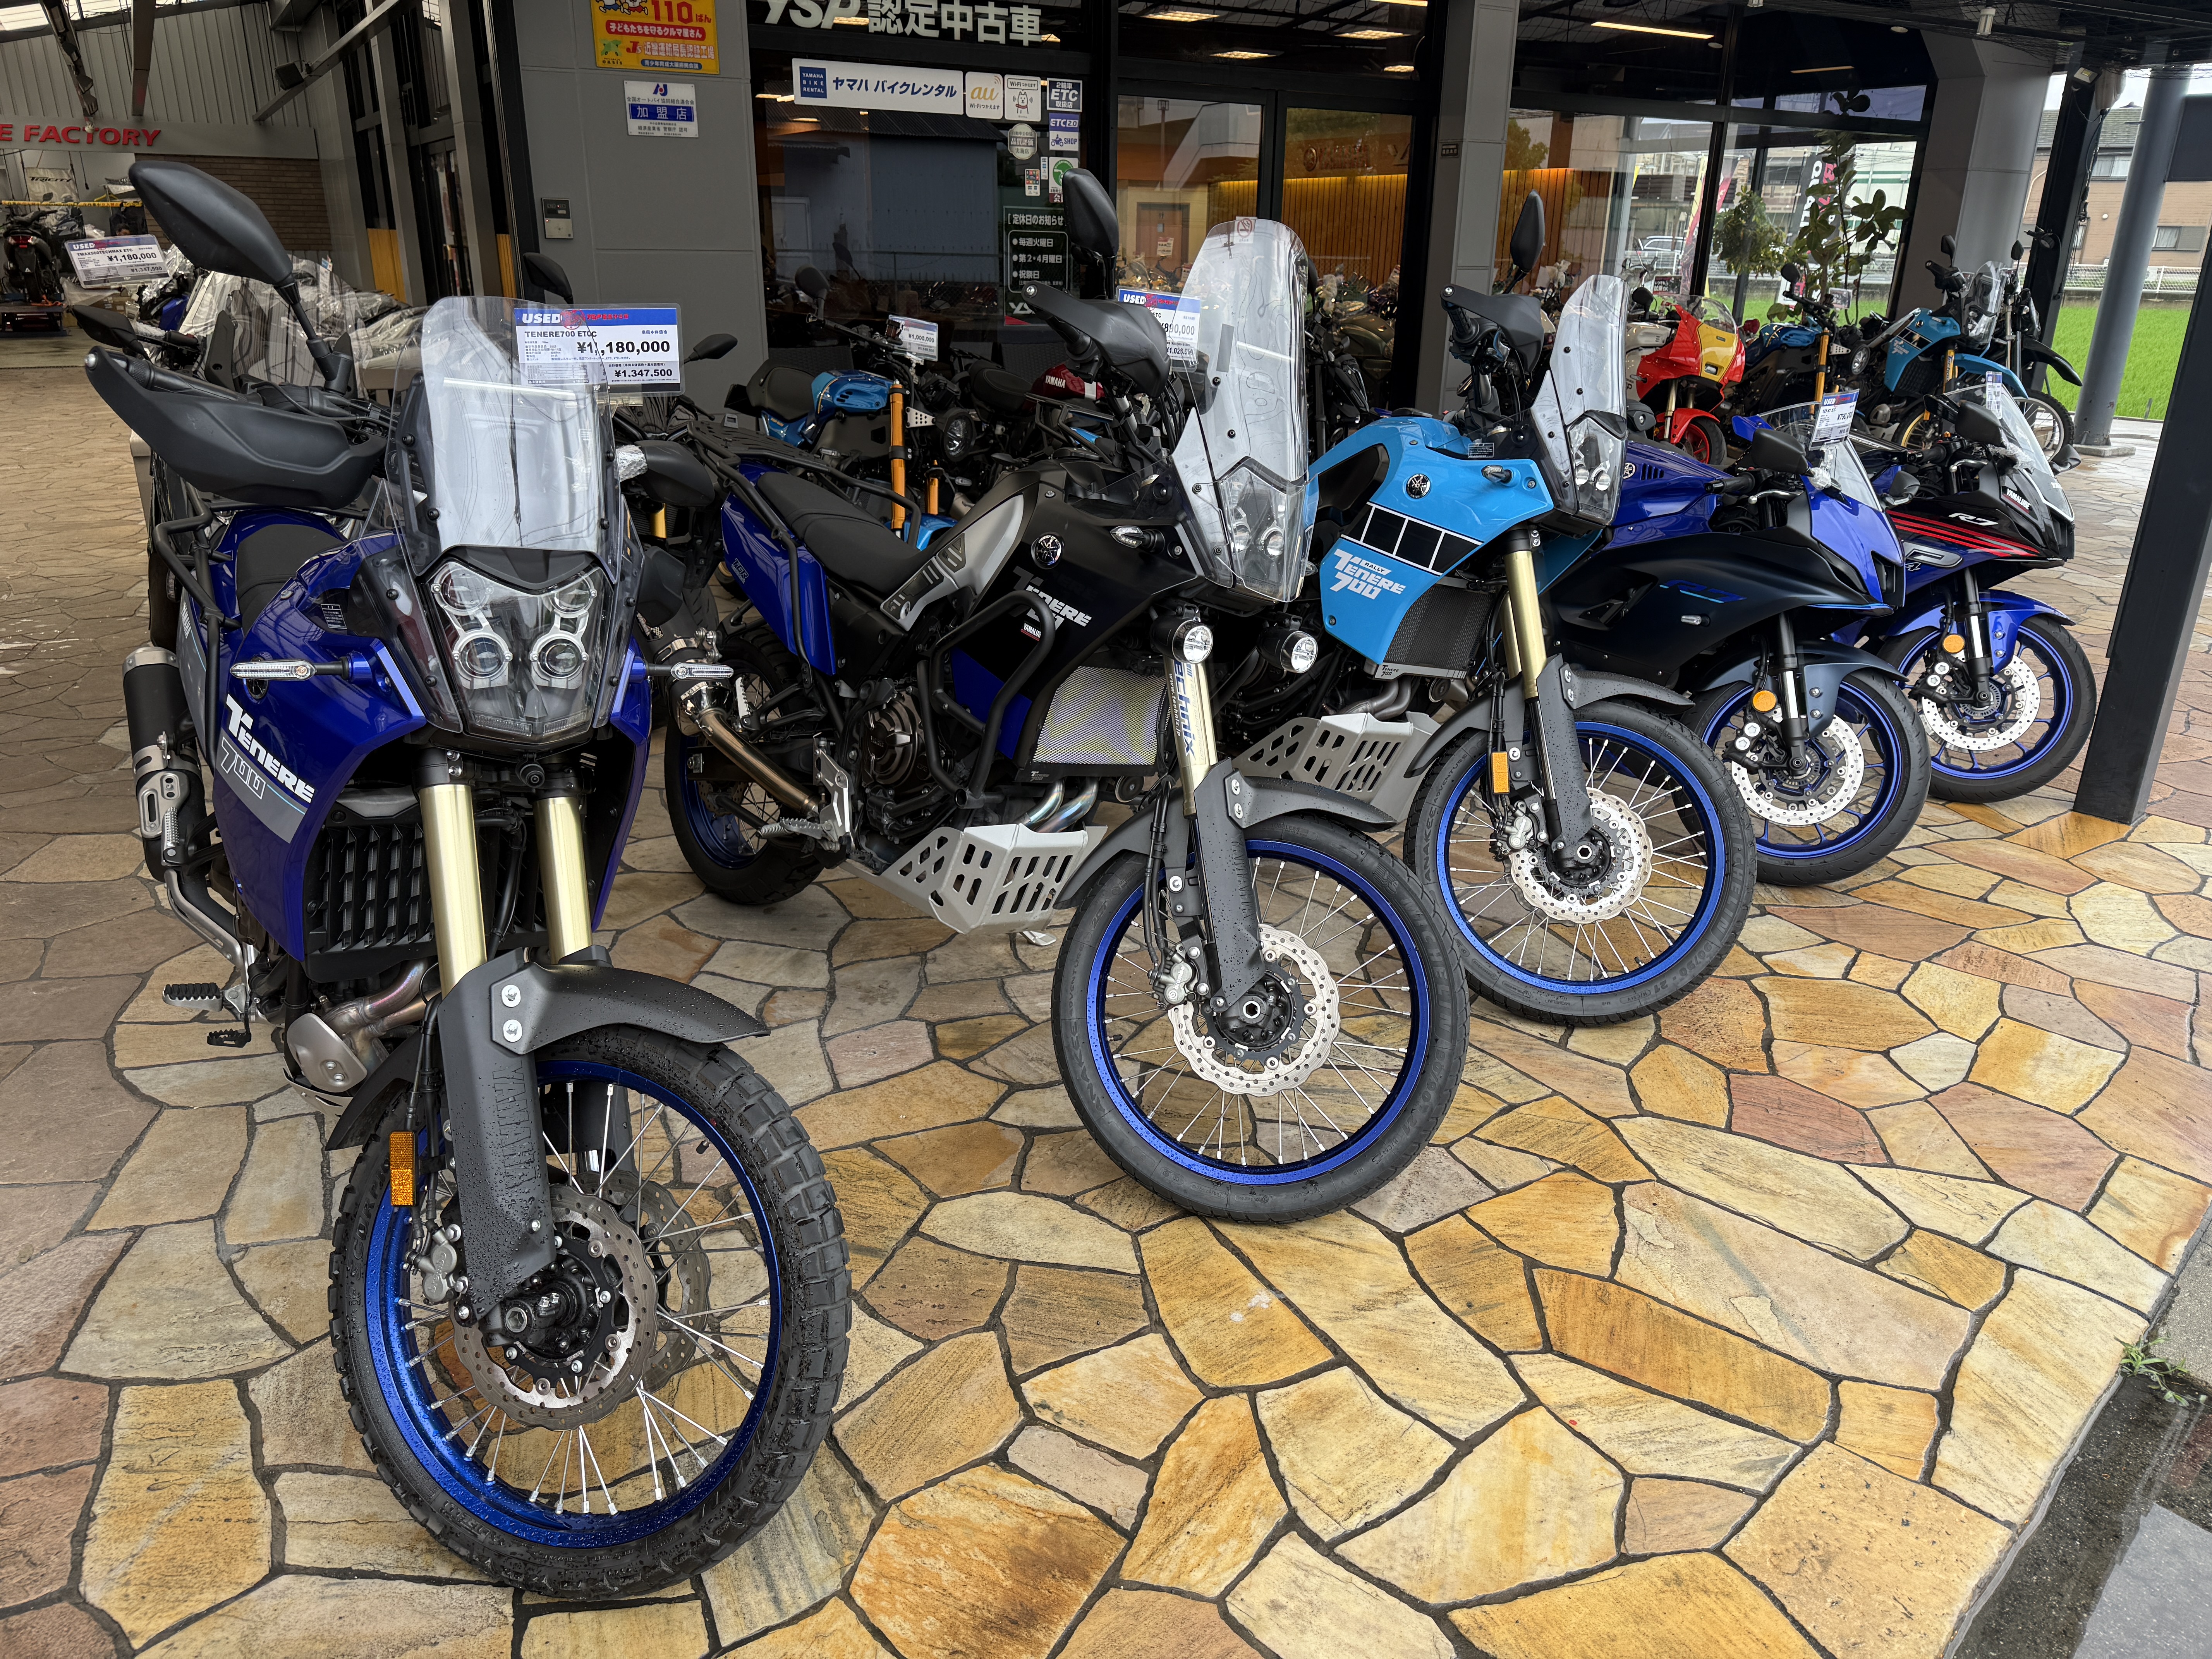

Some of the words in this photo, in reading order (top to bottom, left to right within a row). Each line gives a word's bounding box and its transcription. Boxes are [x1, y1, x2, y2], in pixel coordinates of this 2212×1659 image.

[651, 1, 693, 24] 110
[696, 14, 712, 23] ばん
[869, 0, 1041, 46] 認定中古車
[610, 22, 702, 38] 子どもたちを守るクルマ屋さん
[833, 77, 869, 92] ヤマハ
[874, 80, 957, 98] バイクレンタル
[970, 86, 999, 101] au
[1051, 89, 1079, 102] ETC
[637, 105, 687, 120] 加盟店
[1050, 118, 1066, 127] ETC
[24, 125, 161, 146] FACTORY
[1013, 214, 1064, 226] 定休日のお知らせ
[1019, 238, 1053, 247] 毎週火曜日
[107, 252, 157, 262] ¥1,180,000
[1019, 270, 1039, 279] 祝祭日
[1123, 294, 1146, 305] USED
[522, 313, 562, 324] USED
[908, 333, 934, 343] ¥1,000,000
[615, 369, 672, 377] ¥1,347,500
[1046, 375, 1066, 388] YAMAHA
[2006, 488, 2031, 510] YAMALUBE
[1949, 512, 1999, 526] R7
[1364, 562, 1385, 573] RALLY
[1330, 572, 1382, 599] 700
[1659, 579, 1748, 604] R7
[181, 601, 192, 639] YAMAHA
[1024, 623, 1041, 638] YAMALUB
[1169, 673, 1181, 737] www.technix.jp
[1174, 660, 1196, 761] echnix
[221, 737, 266, 800] 700
[1424, 806, 1438, 883] ANAKEE
[1434, 753, 1468, 803] ADVENTURE
[1718, 823, 1744, 935] MICHELIN
[1401, 898, 1452, 1033] MICHELIN
[1069, 945, 1085, 1017] ADVENTURE
[1173, 966, 1185, 990] brembo
[1070, 1020, 1106, 1113] ANAKEE
[492, 1060, 539, 1191] YAMAHA
[351, 1158, 390, 1281] SCORPIO
